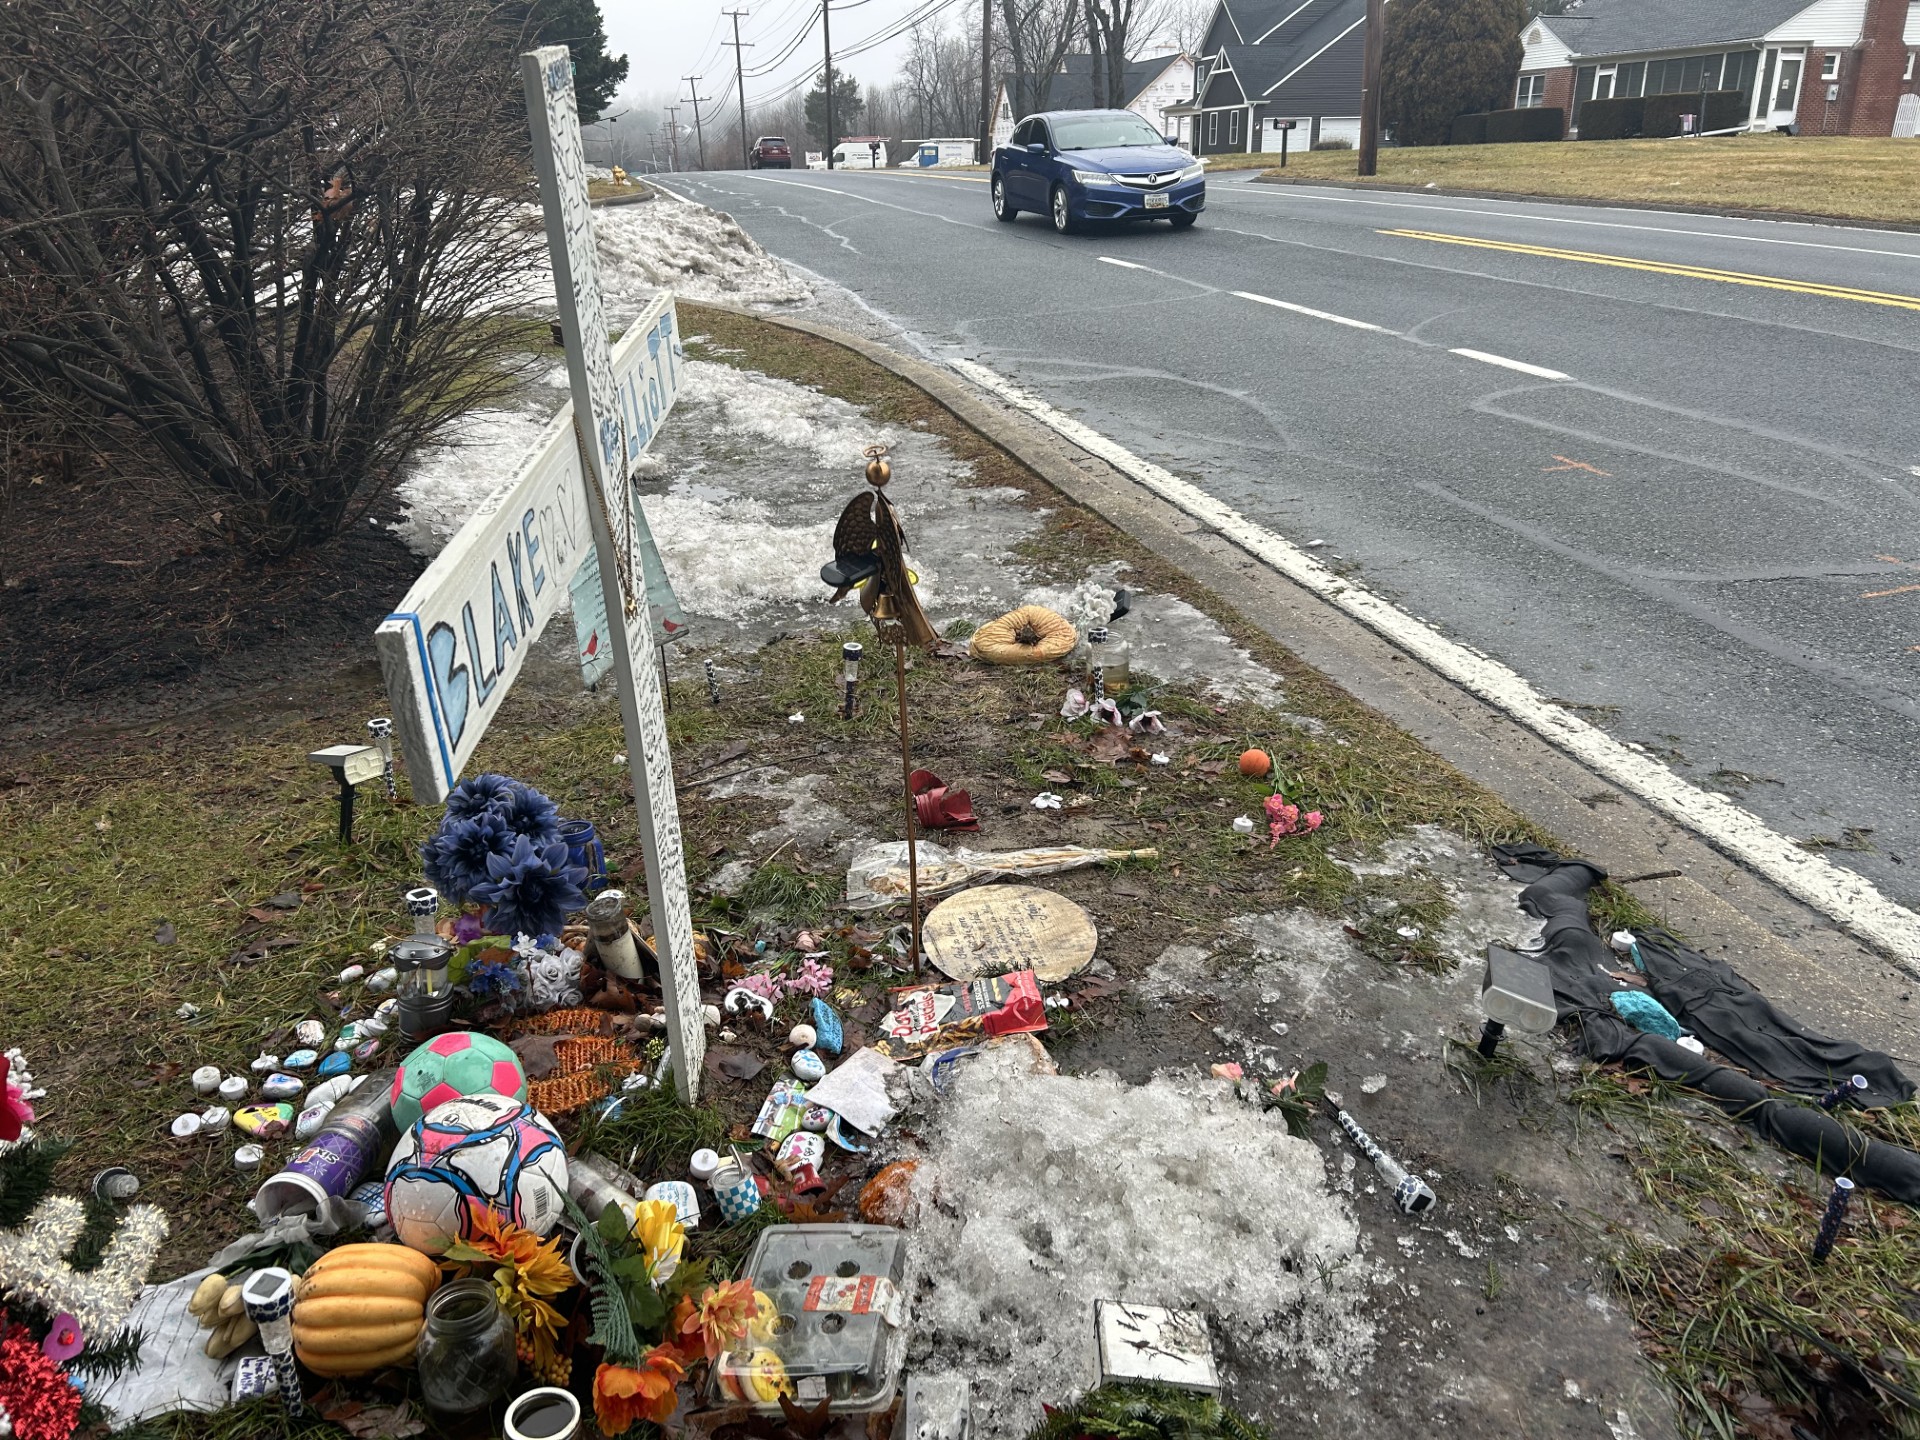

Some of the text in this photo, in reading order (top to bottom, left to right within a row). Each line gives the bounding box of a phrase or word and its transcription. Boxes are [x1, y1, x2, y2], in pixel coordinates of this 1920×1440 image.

[427, 508, 545, 754] BLAKE
[967, 910, 983, 924] that
[1027, 904, 1047, 920] John
[952, 947, 967, 959] God
[972, 980, 983, 1009] SEASONED
[920, 991, 937, 1034] Pretzels
